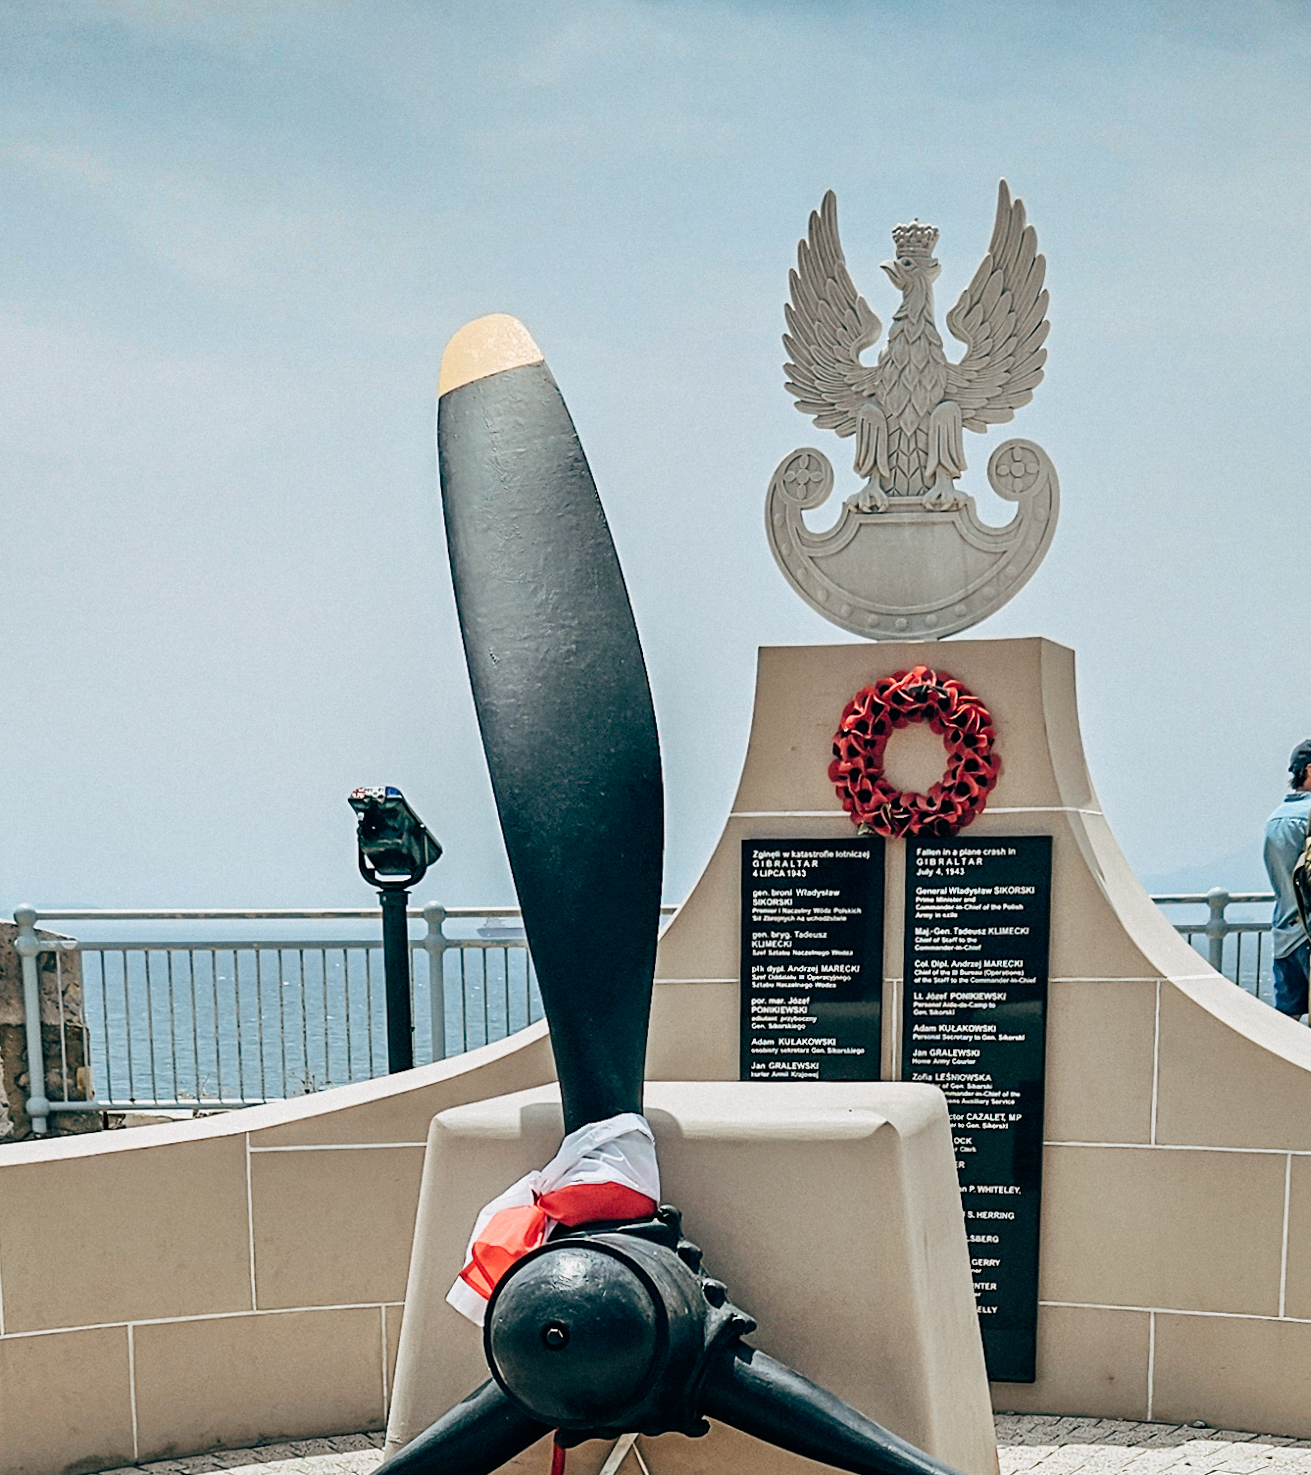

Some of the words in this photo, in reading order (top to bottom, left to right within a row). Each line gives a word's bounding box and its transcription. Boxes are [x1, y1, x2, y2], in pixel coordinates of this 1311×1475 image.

[787, 869, 806, 877] 1943
[994, 886, 1035, 895] SIKORSKI
[753, 898, 793, 906] SIKORSKI
[929, 1049, 980, 1057] GRALEWSKI
[769, 1062, 819, 1070] GRALEWSKI
[976, 1211, 1014, 1220] HERRING
